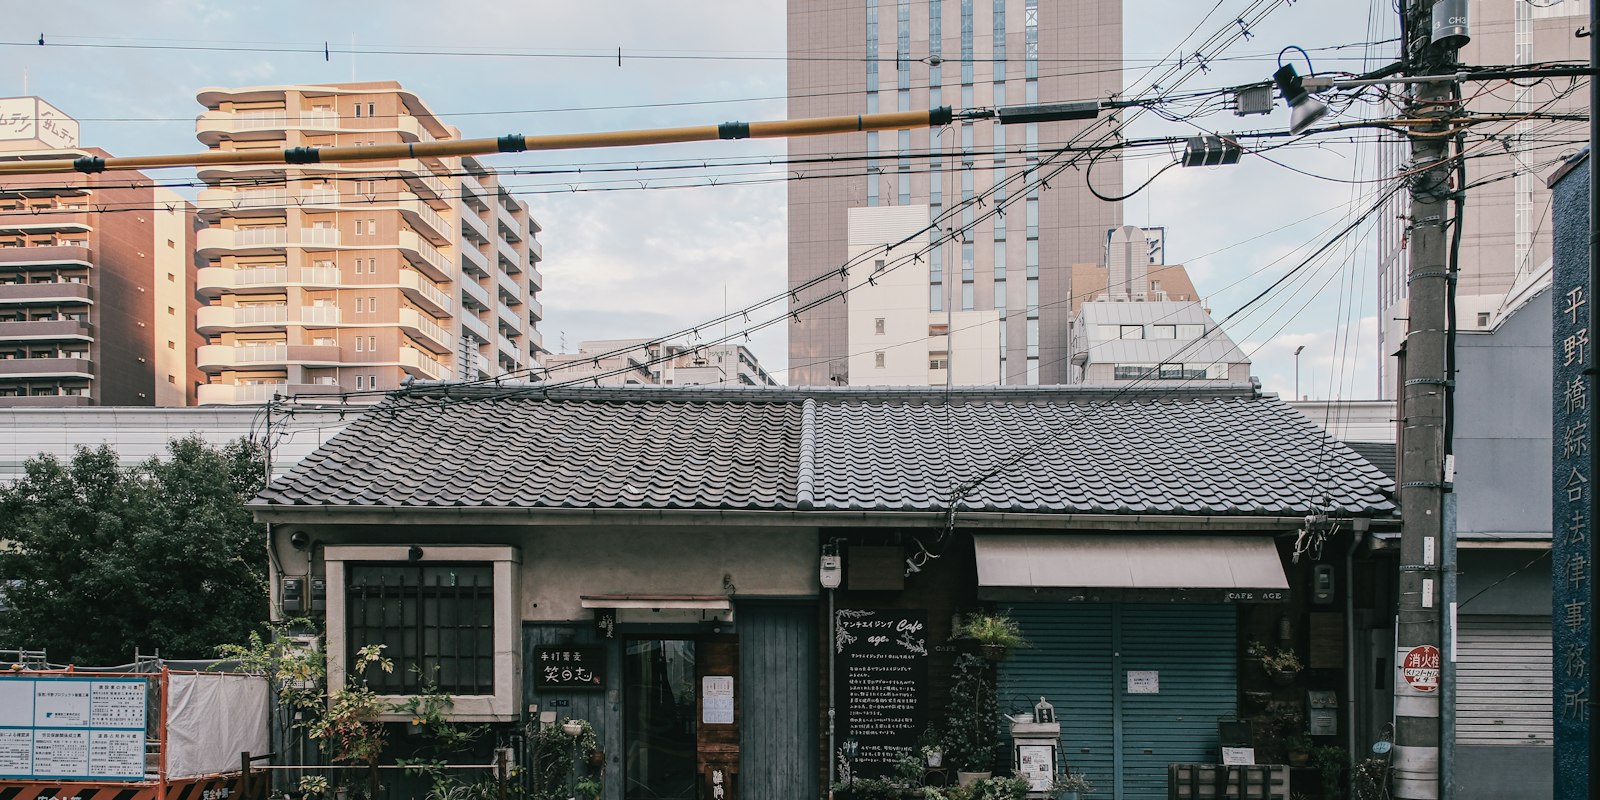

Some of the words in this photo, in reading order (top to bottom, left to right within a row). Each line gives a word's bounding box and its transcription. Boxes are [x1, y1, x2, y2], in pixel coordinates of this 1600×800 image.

[1563, 286, 1589, 722] 平野橋綜合法律事務所
[1229, 592, 1253, 600] CAFE
[1262, 592, 1282, 600] AGE
[843, 621, 893, 629] アンチエイジング
[896, 619, 923, 633] Cafe
[541, 651, 582, 662] 手打蕎麦
